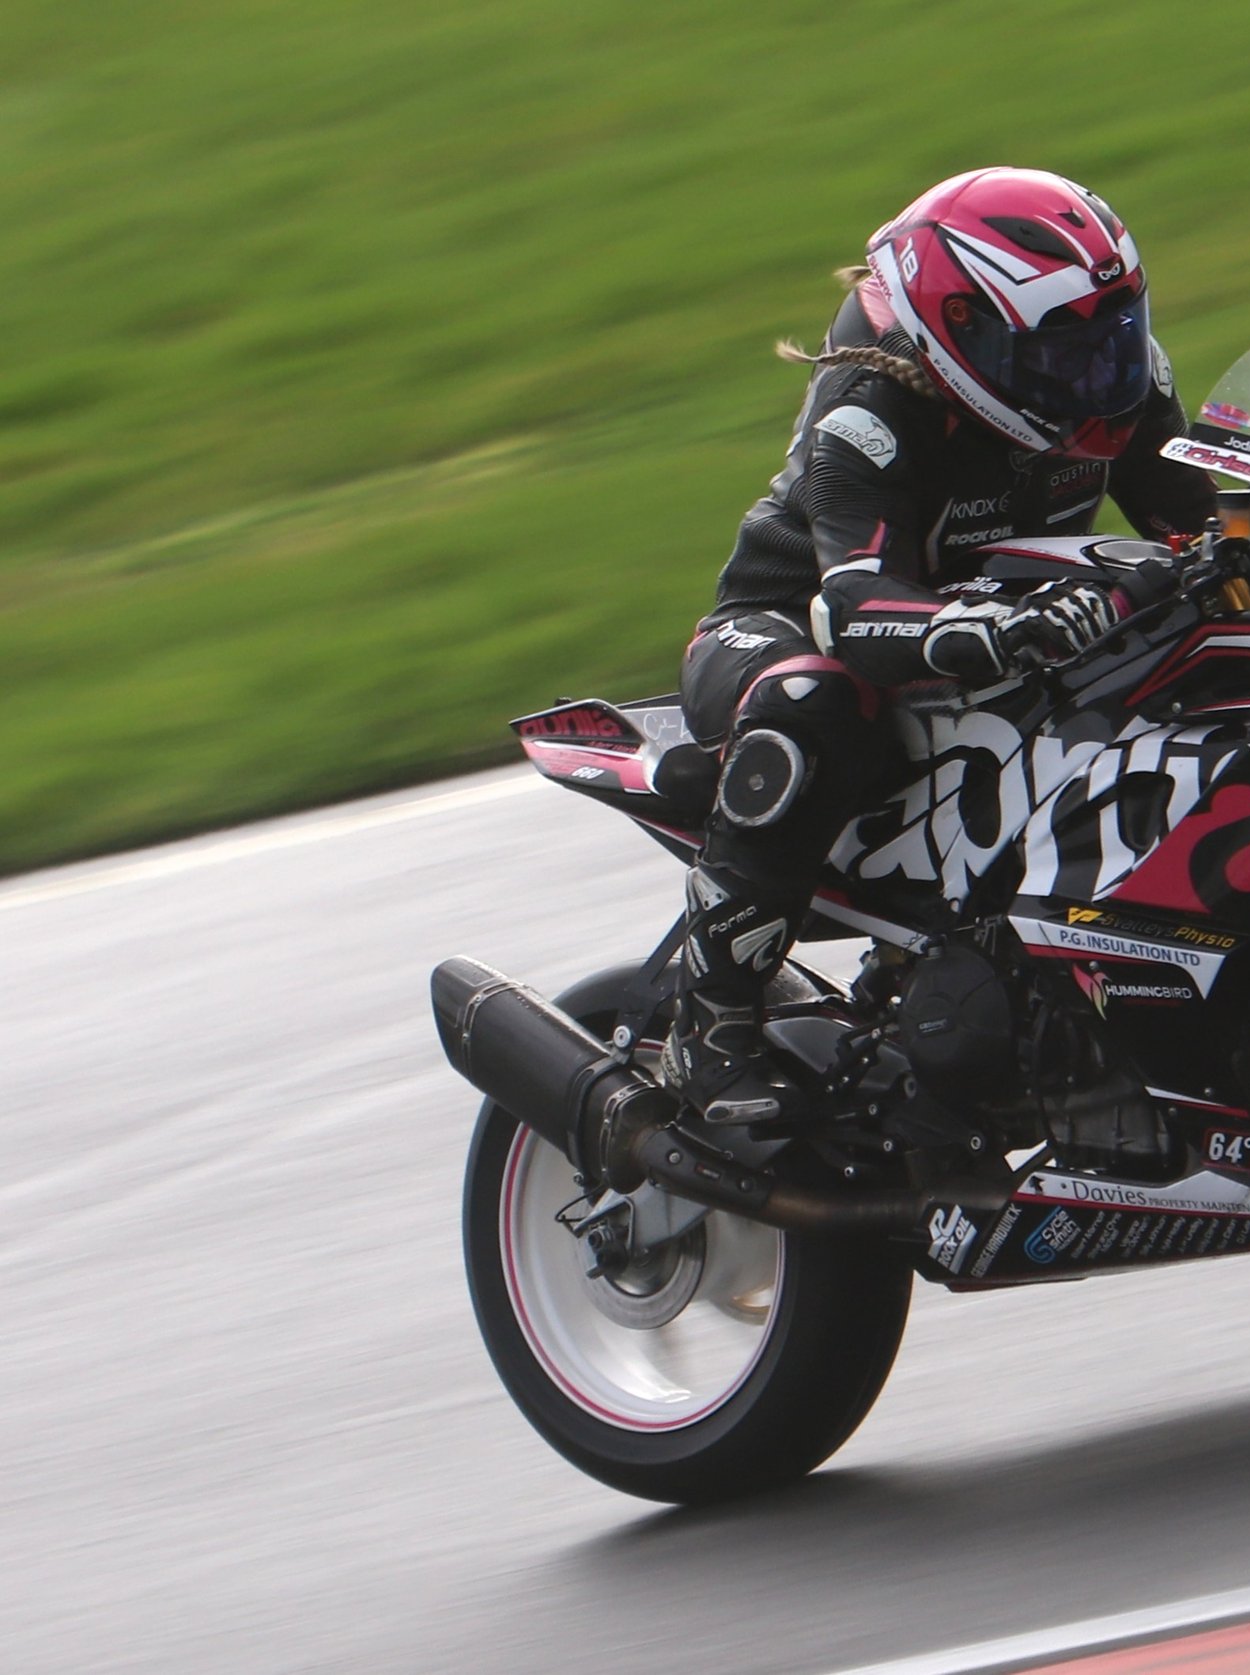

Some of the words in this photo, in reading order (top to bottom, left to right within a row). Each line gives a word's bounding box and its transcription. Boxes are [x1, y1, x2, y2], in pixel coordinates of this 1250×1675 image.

[899, 236, 919, 283] 18
[1010, 428, 1033, 442] LTD
[1050, 462, 1101, 487] austin
[951, 497, 997, 519] KNOX
[945, 531, 988, 546] ROCK
[989, 525, 1014, 540] OIL
[571, 766, 604, 780] 660
[1087, 935, 1172, 961] INSULATION
[1174, 952, 1201, 966] LTD
[1071, 1179, 1147, 1207] Davies
[1148, 1196, 1199, 1211] PROPERTY
[937, 1237, 959, 1267] ROCK
[954, 1216, 970, 1241] OIL
[987, 1203, 1023, 1256] HARDWICK
[1049, 1219, 1078, 1249] smith
